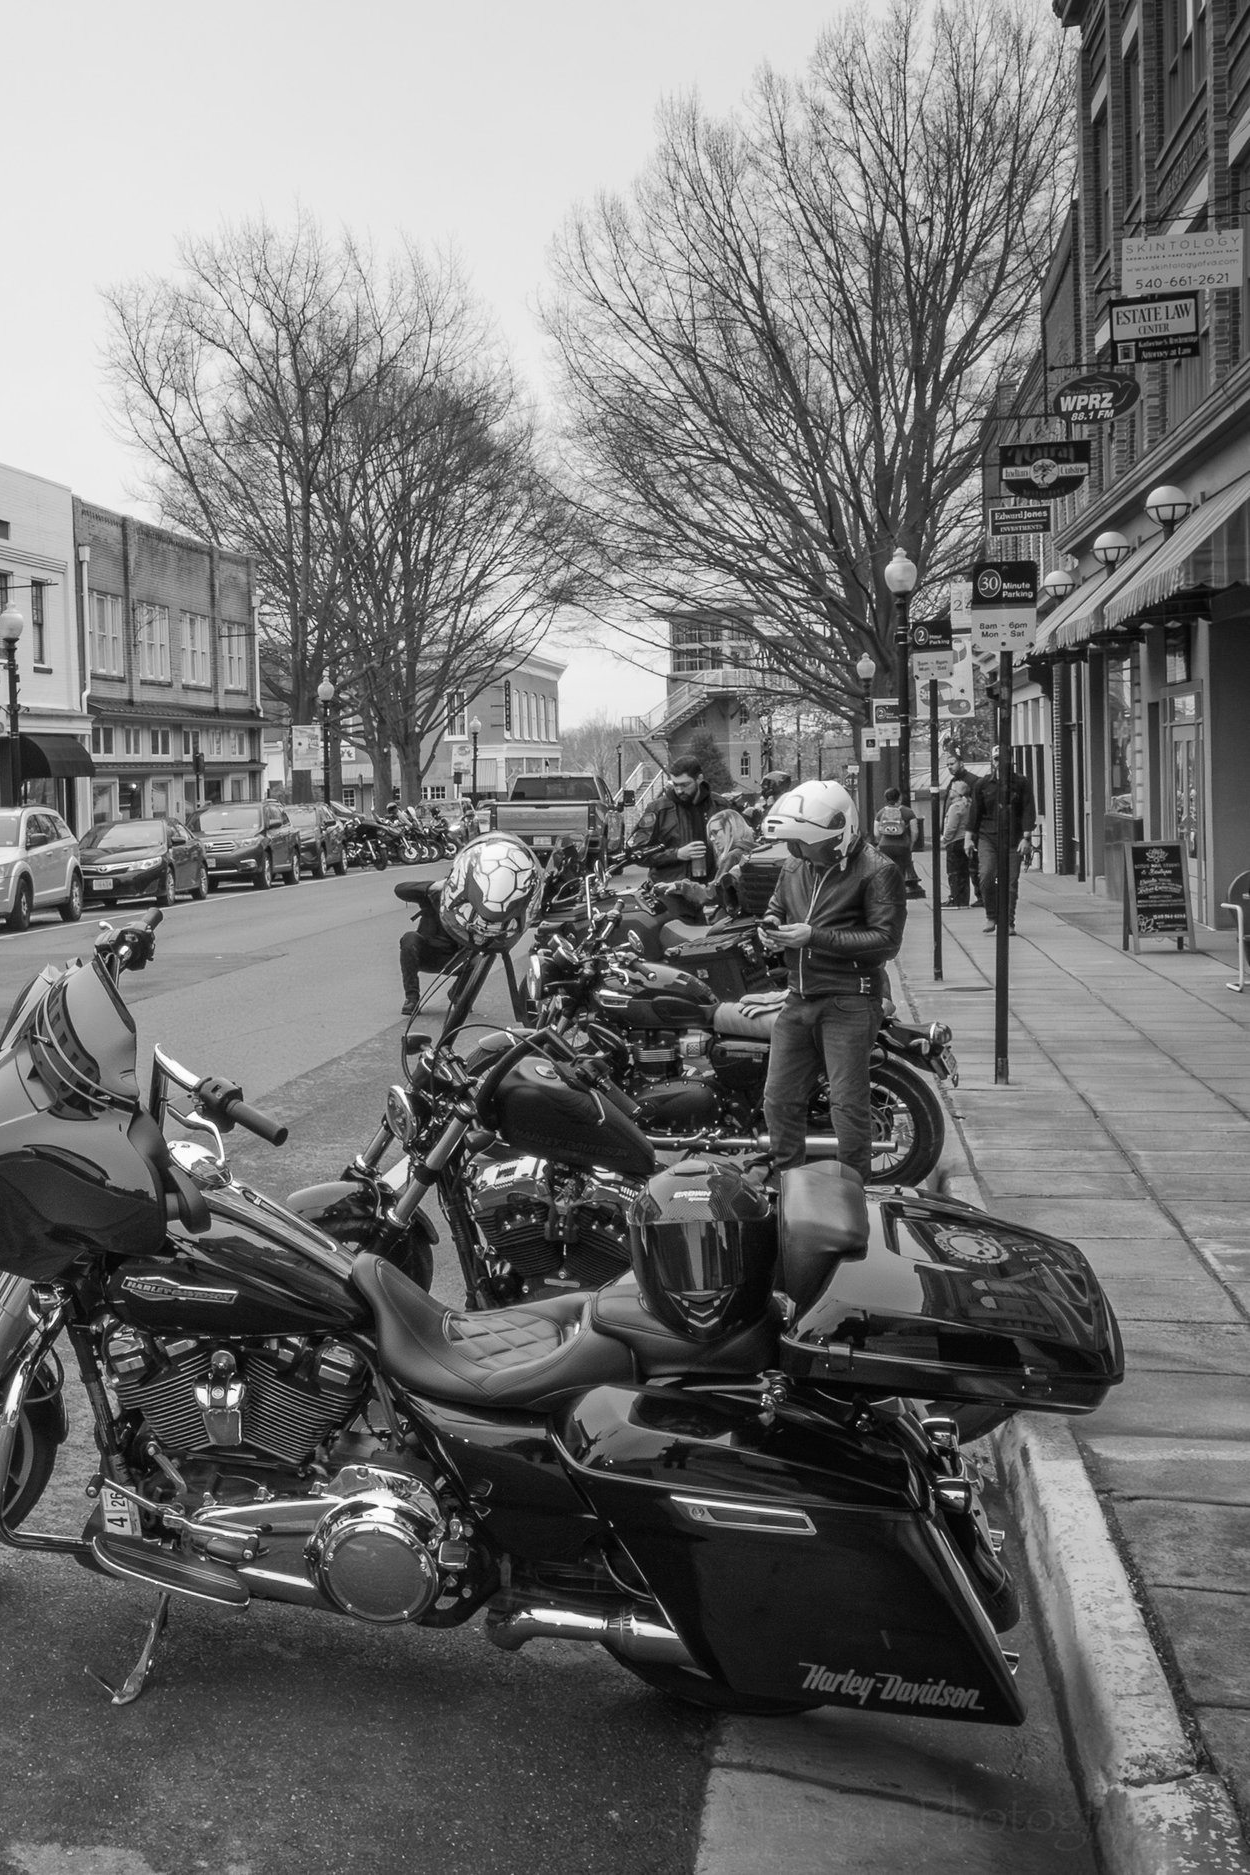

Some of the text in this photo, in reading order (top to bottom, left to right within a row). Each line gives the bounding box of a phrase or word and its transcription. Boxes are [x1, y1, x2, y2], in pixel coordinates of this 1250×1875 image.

[1126, 236, 1240, 254] SKINTOLOGY
[1135, 272, 1229, 290] 540-661-2621
[1116, 303, 1192, 326] ESTATE LAW
[1138, 323, 1170, 335] CENTER
[1060, 392, 1114, 412] WPRZ
[1070, 409, 1115, 421] 88.1 FM
[981, 576, 998, 591] 30
[1002, 590, 1034, 599] Parking
[979, 622, 998, 630] 8am
[1008, 621, 1028, 629] 6pm
[918, 630, 925, 642] 2
[799, 1662, 985, 1711] Harley-Davidson
